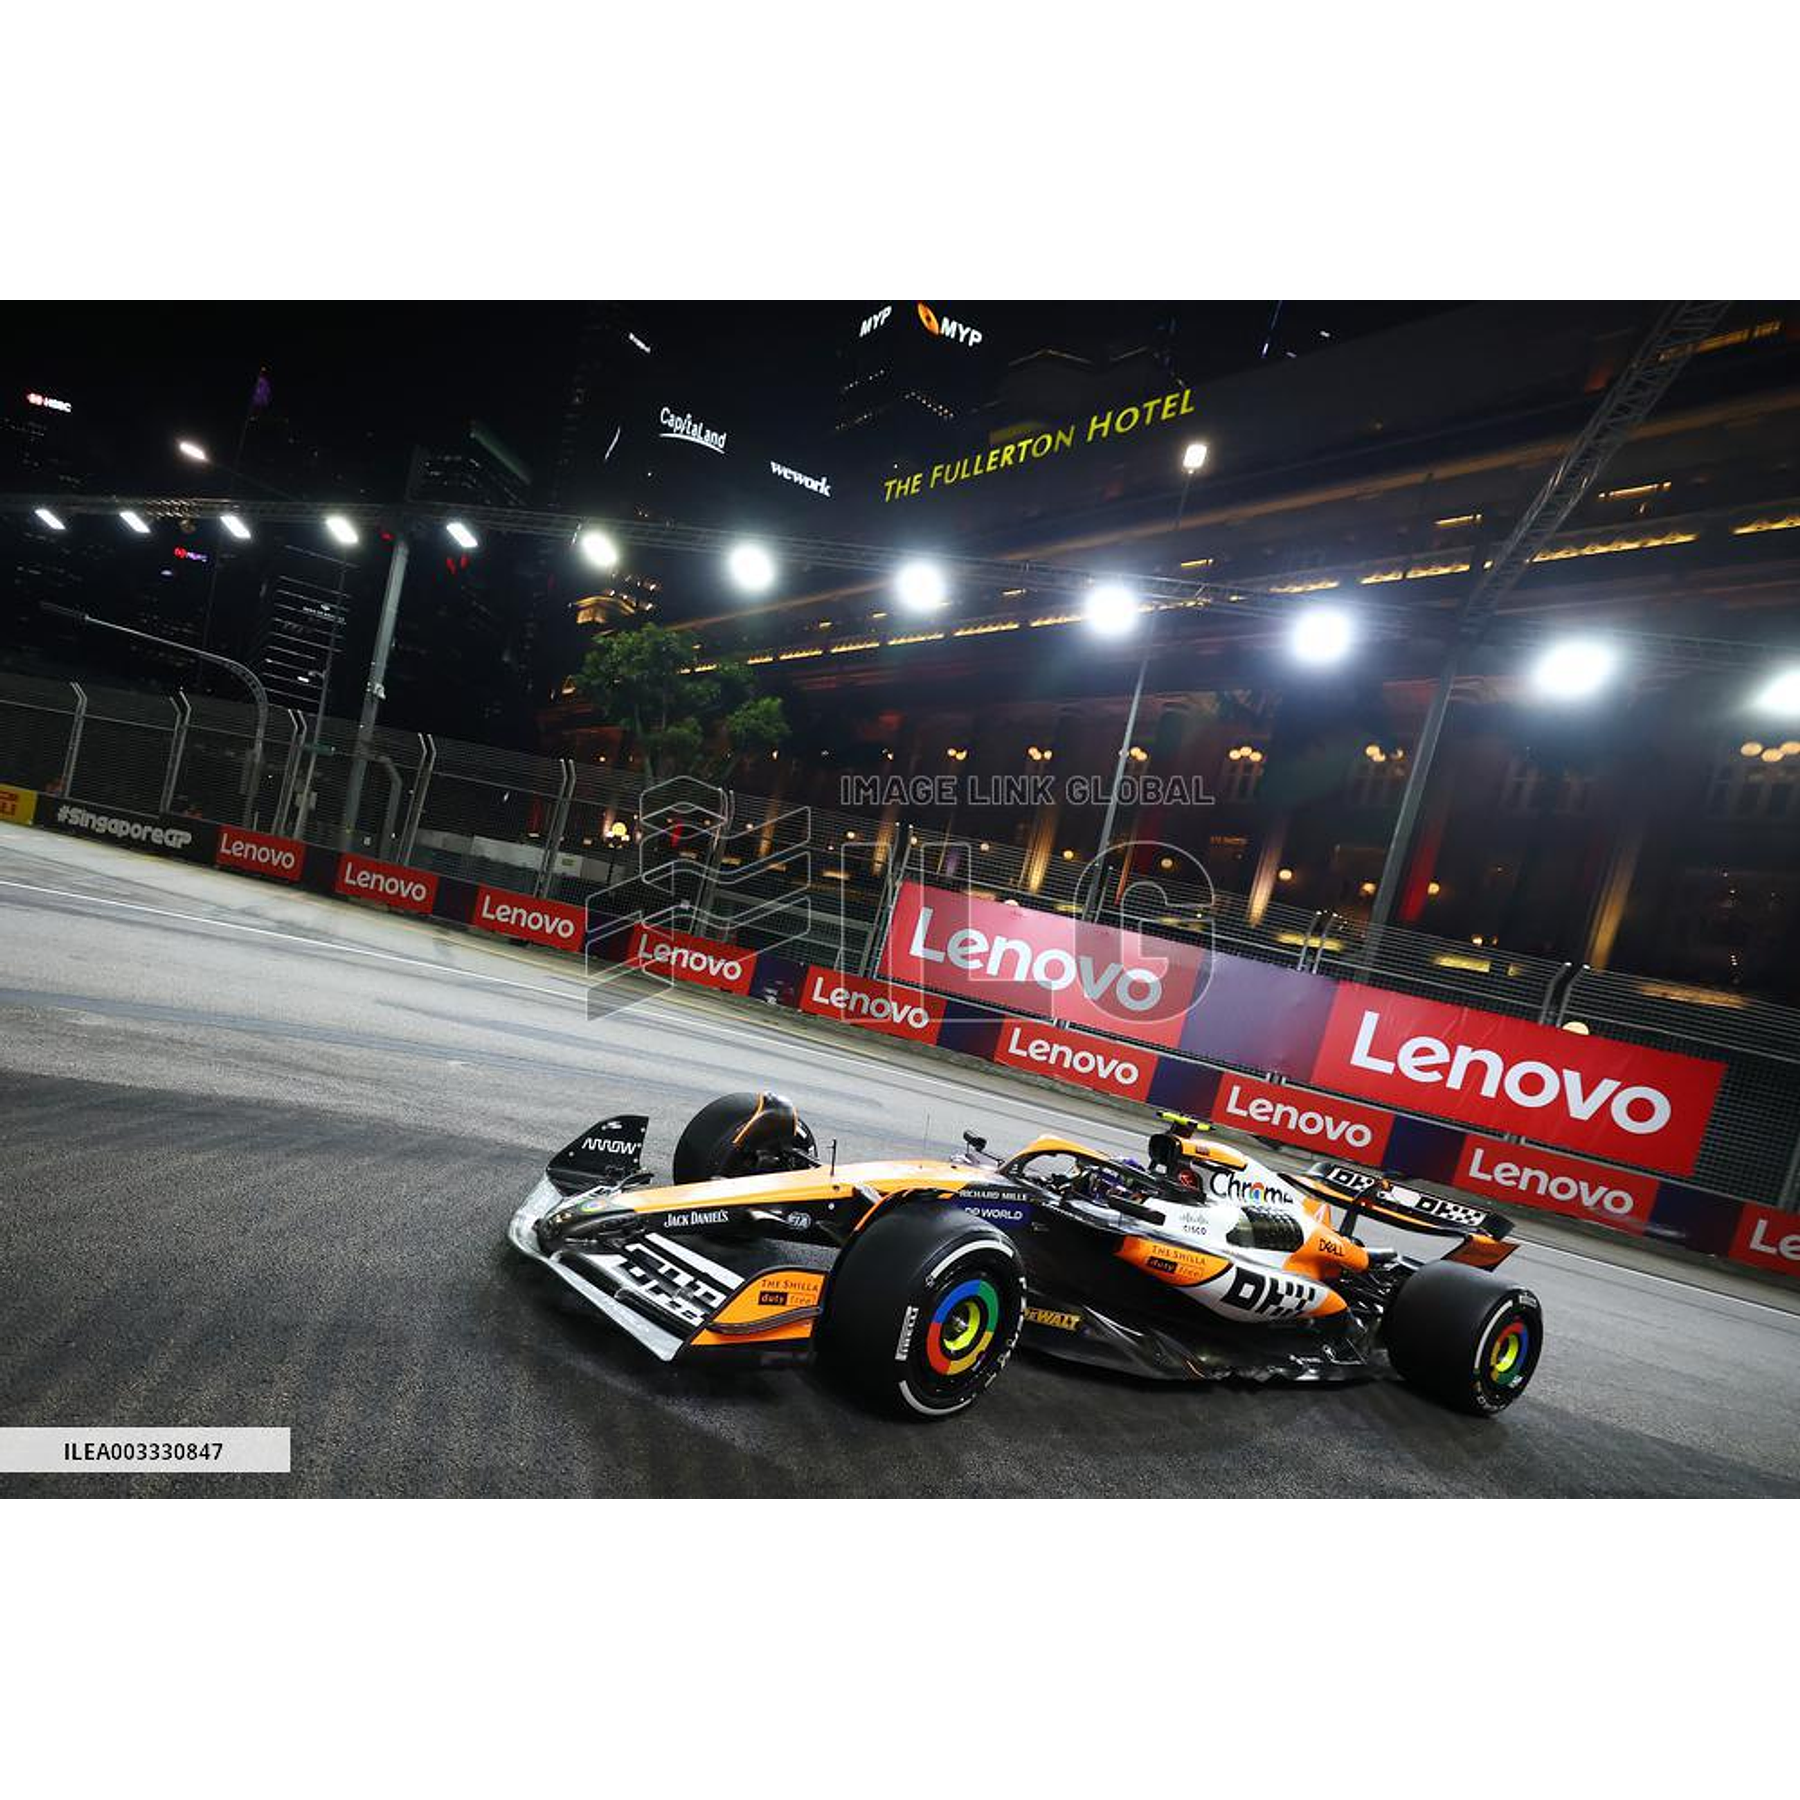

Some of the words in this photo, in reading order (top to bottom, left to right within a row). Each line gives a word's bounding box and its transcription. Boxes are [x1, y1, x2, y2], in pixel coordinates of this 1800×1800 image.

[859, 305, 892, 338] MYP
[940, 316, 983, 347] MYP
[660, 406, 727, 449] CapitaLand
[884, 473, 923, 502] THE
[930, 425, 1076, 488] FULLERTON
[1087, 389, 1195, 442] HOTEL
[770, 461, 831, 498] wework
[219, 831, 296, 870] Lenovo
[344, 862, 427, 902] Lenovo
[481, 895, 575, 939] Lenovo
[637, 933, 743, 981] Lenovo
[908, 906, 1163, 1012] Lenovo
[811, 976, 931, 1029] Lenovo
[1007, 1027, 1140, 1086] Lenovo
[1349, 1010, 1672, 1135] Lenovo
[1225, 1085, 1374, 1148] Lenovo
[1001, 1191, 1027, 1201] MILLE
[1468, 1148, 1634, 1216] Lenovo
[664, 1213, 689, 1228] JACK
[982, 1207, 1023, 1220] WORLD
[760, 1278, 778, 1289] THE
[782, 1279, 820, 1293] SHILLA
[760, 1293, 785, 1304] duty
